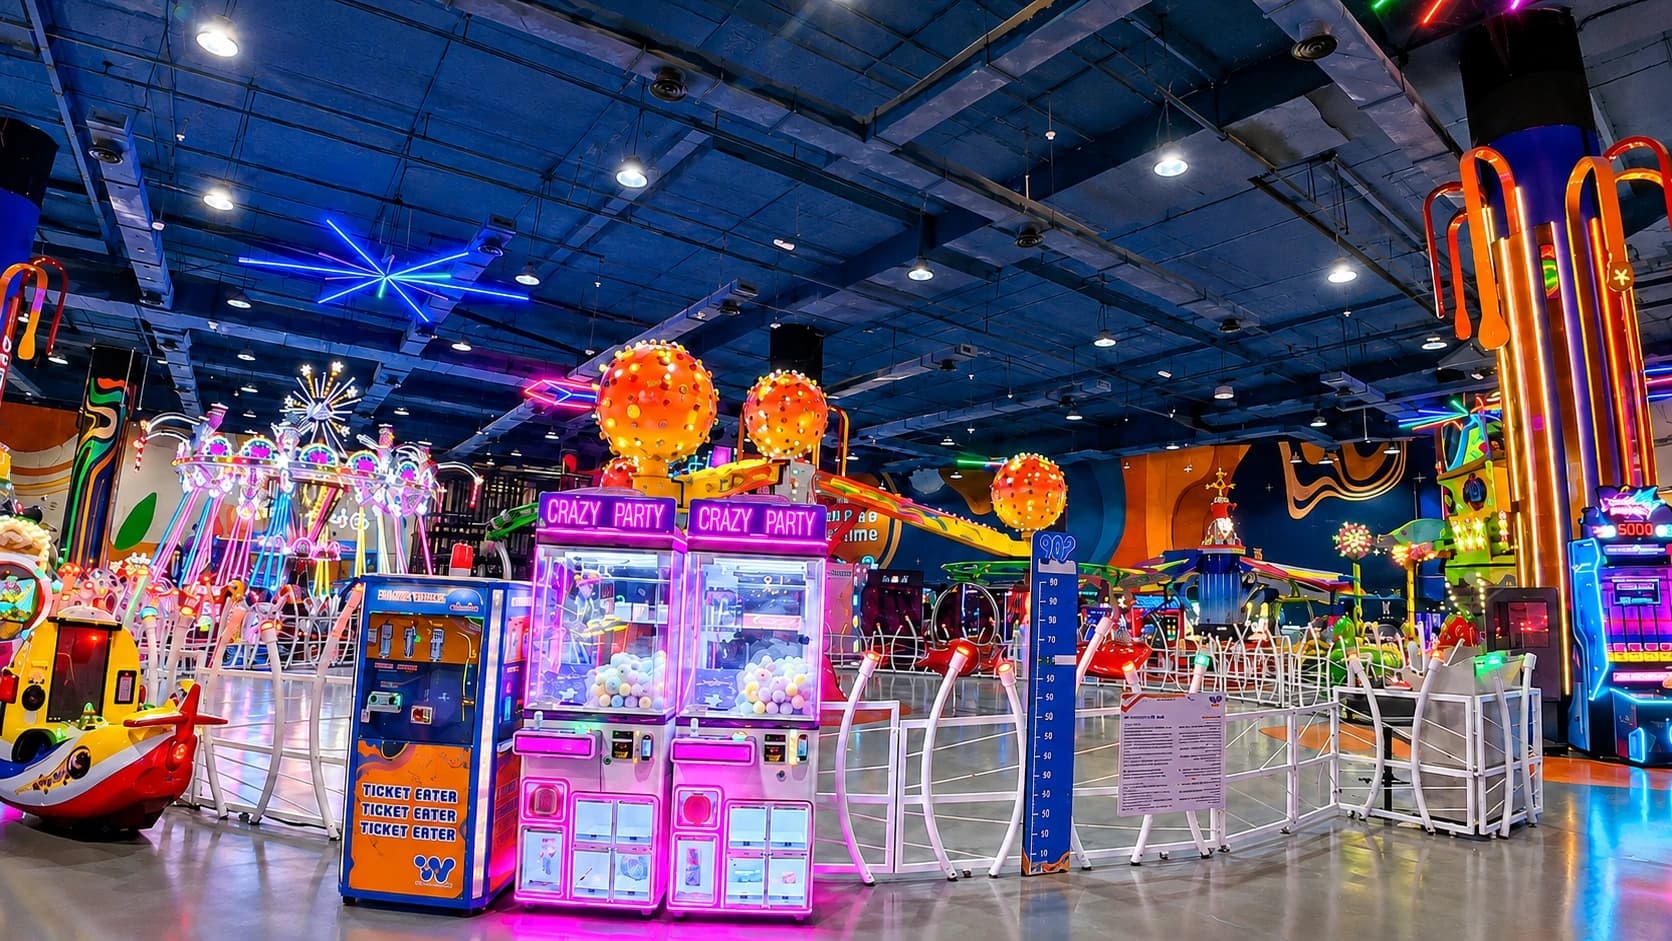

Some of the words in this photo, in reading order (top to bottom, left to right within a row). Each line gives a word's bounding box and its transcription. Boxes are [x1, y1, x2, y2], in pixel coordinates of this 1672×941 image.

[546, 498, 600, 525] CRAZY
[614, 502, 665, 529] PARTY
[698, 506, 752, 533] CRAZY
[766, 510, 816, 536] PARTY
[1618, 523, 1654, 536] 5000
[1047, 635, 1056, 644] 70
[362, 783, 411, 800] TICKET
[415, 788, 458, 803] EATER
[361, 802, 409, 818] TICKET
[413, 807, 457, 822] EATER
[360, 821, 408, 838] TICKET
[412, 826, 456, 842] EATER
